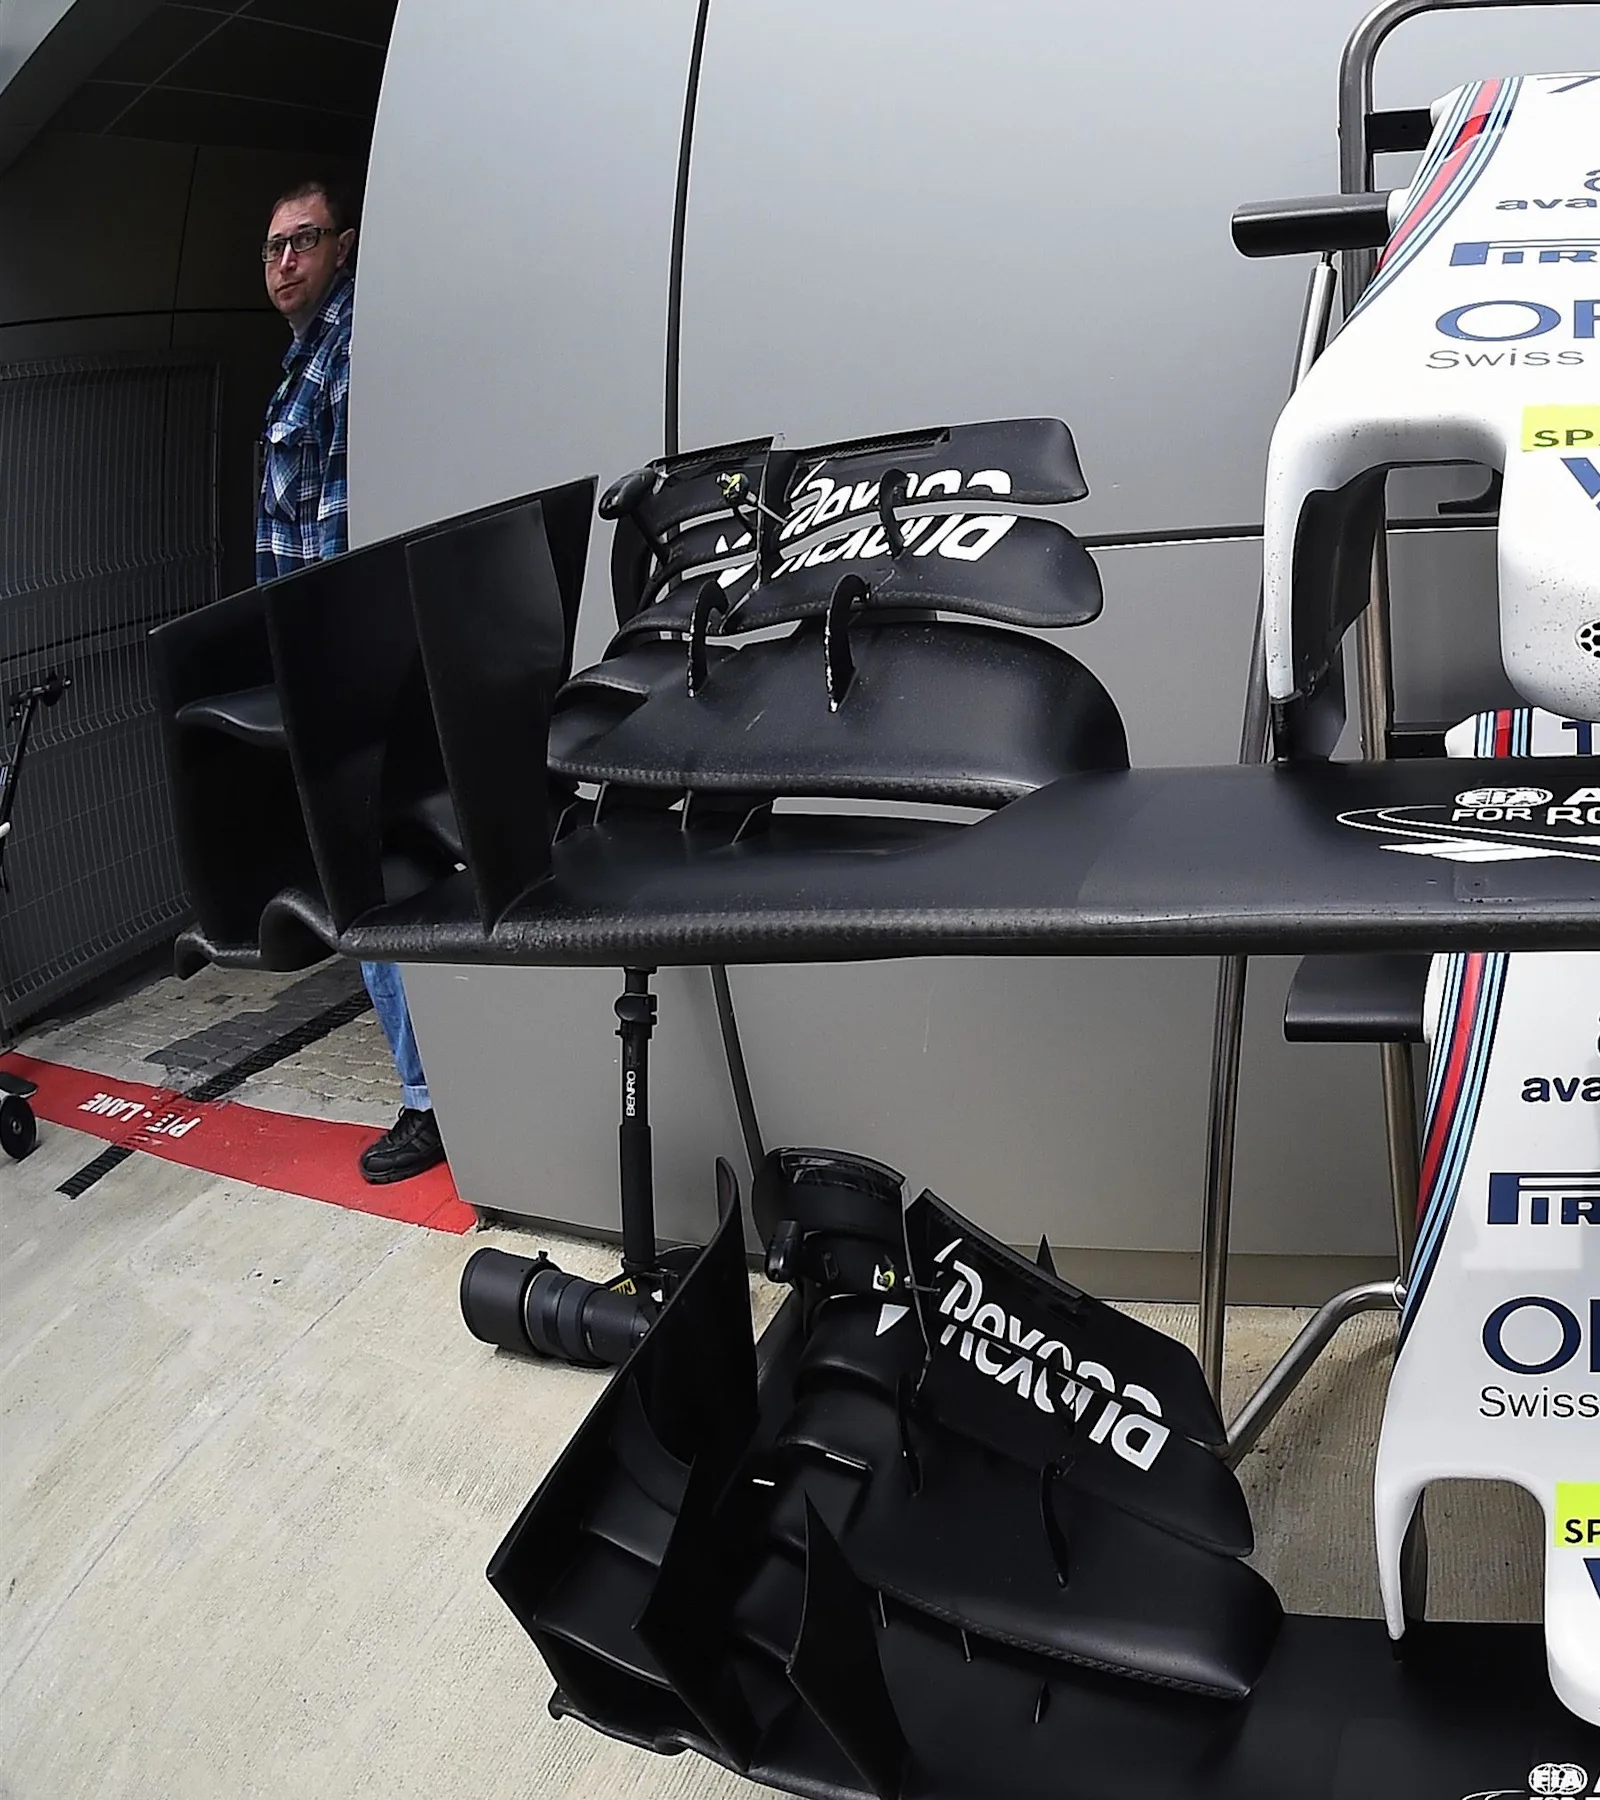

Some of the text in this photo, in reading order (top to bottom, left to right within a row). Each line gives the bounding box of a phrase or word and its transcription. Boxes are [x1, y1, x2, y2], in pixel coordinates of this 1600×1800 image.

[1425, 349, 1584, 370] Swiss
[1451, 807, 1533, 823] FOR
[625, 1070, 637, 1117] BENRO
[1479, 1385, 1600, 1418] Swiss
